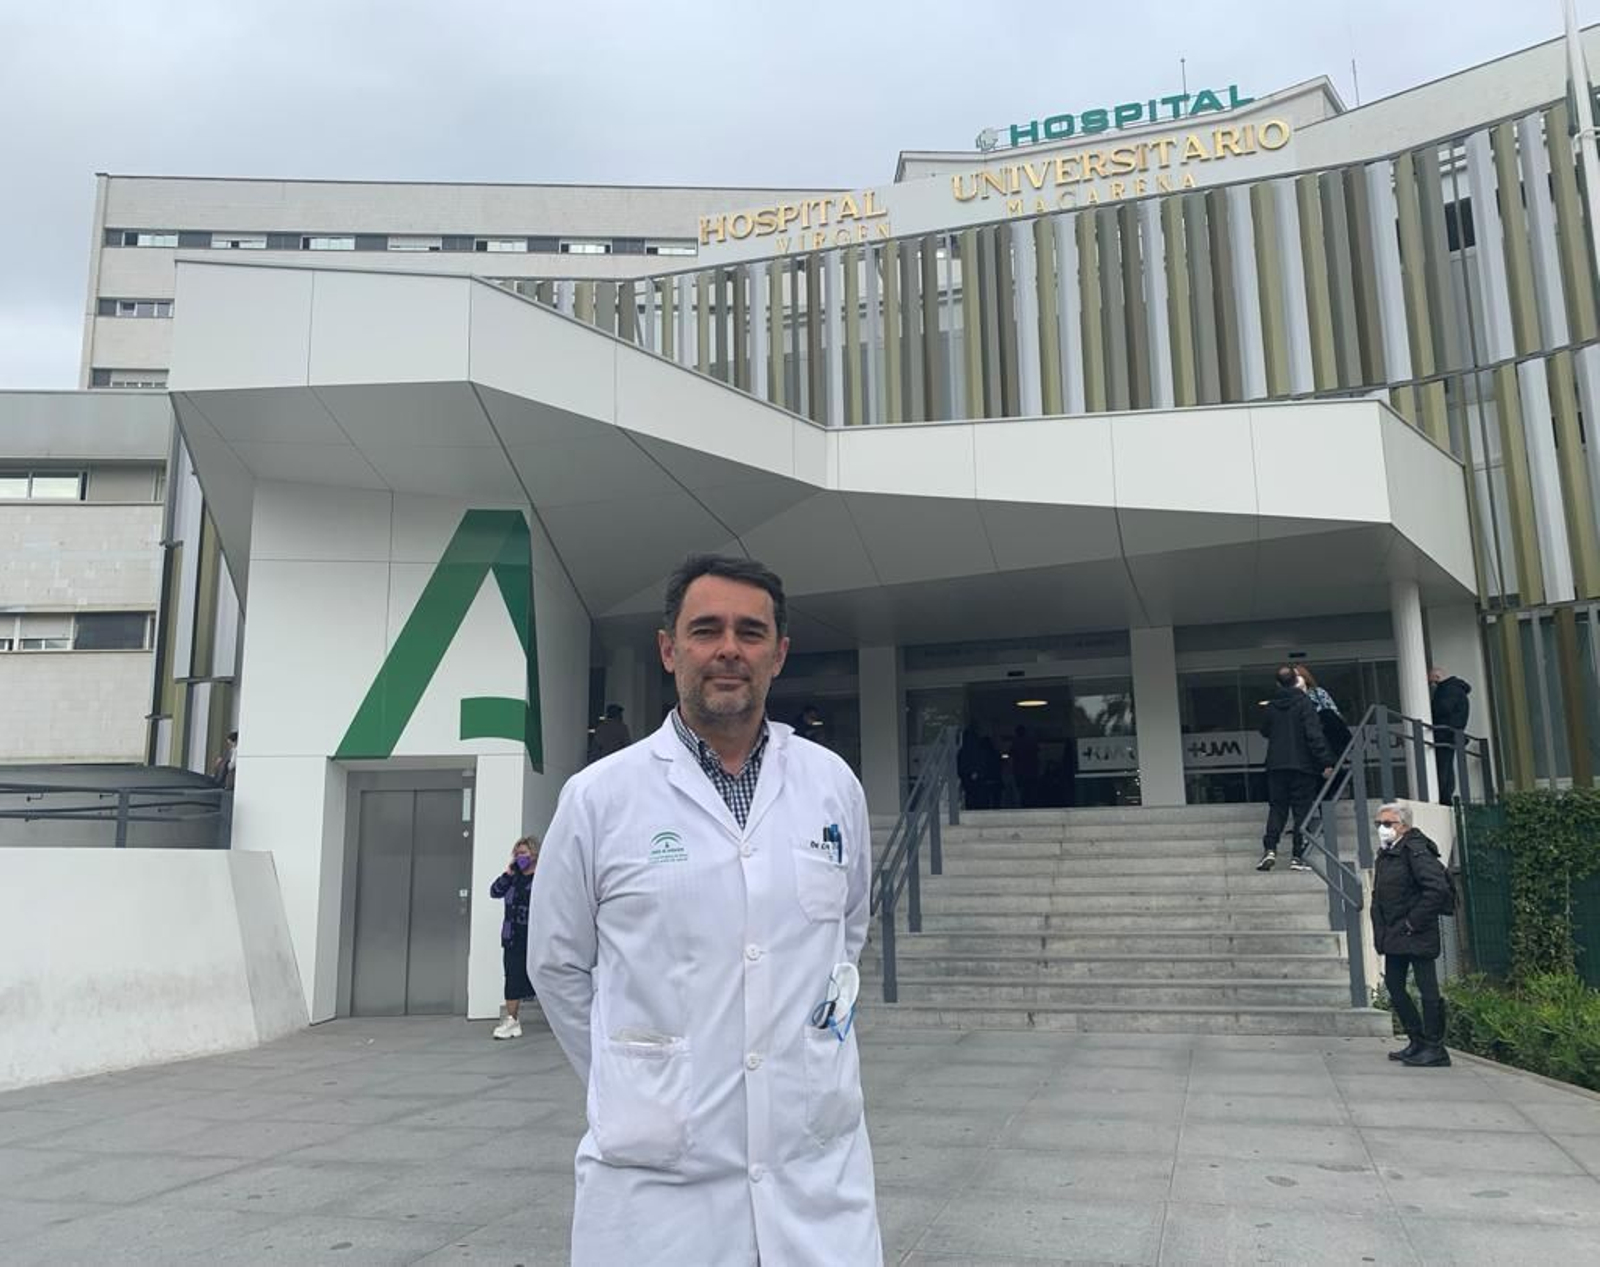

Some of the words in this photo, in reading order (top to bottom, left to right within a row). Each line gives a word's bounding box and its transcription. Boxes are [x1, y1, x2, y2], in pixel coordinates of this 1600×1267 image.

[1010, 85, 1254, 147] HOSPITAL
[700, 191, 887, 245] HOSPITAL
[952, 120, 1290, 201] UNIVERSITARIO
[776, 222, 892, 254] VIRGEN
[1007, 173, 1196, 218] MACARENA
